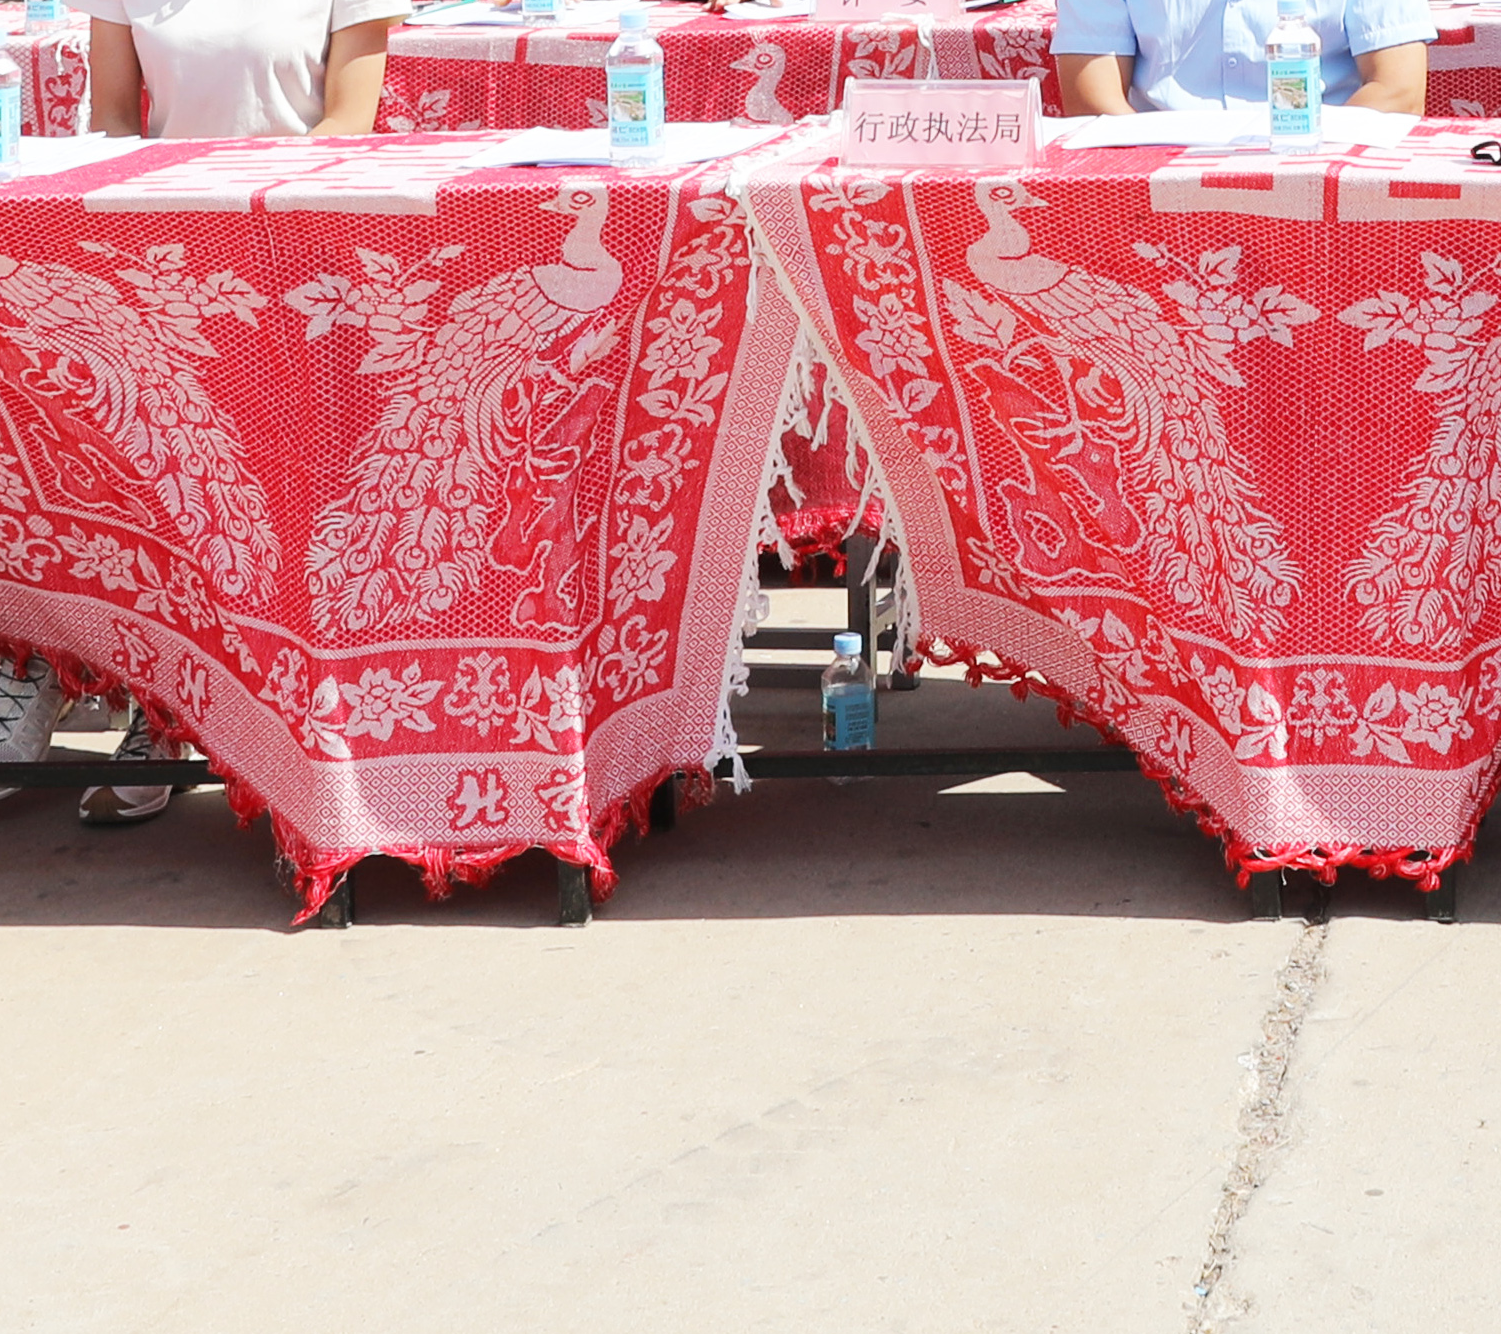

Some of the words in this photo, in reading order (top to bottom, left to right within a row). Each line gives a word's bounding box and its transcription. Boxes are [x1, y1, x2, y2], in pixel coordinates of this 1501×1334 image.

[853, 111, 1023, 144] 行政执法局
